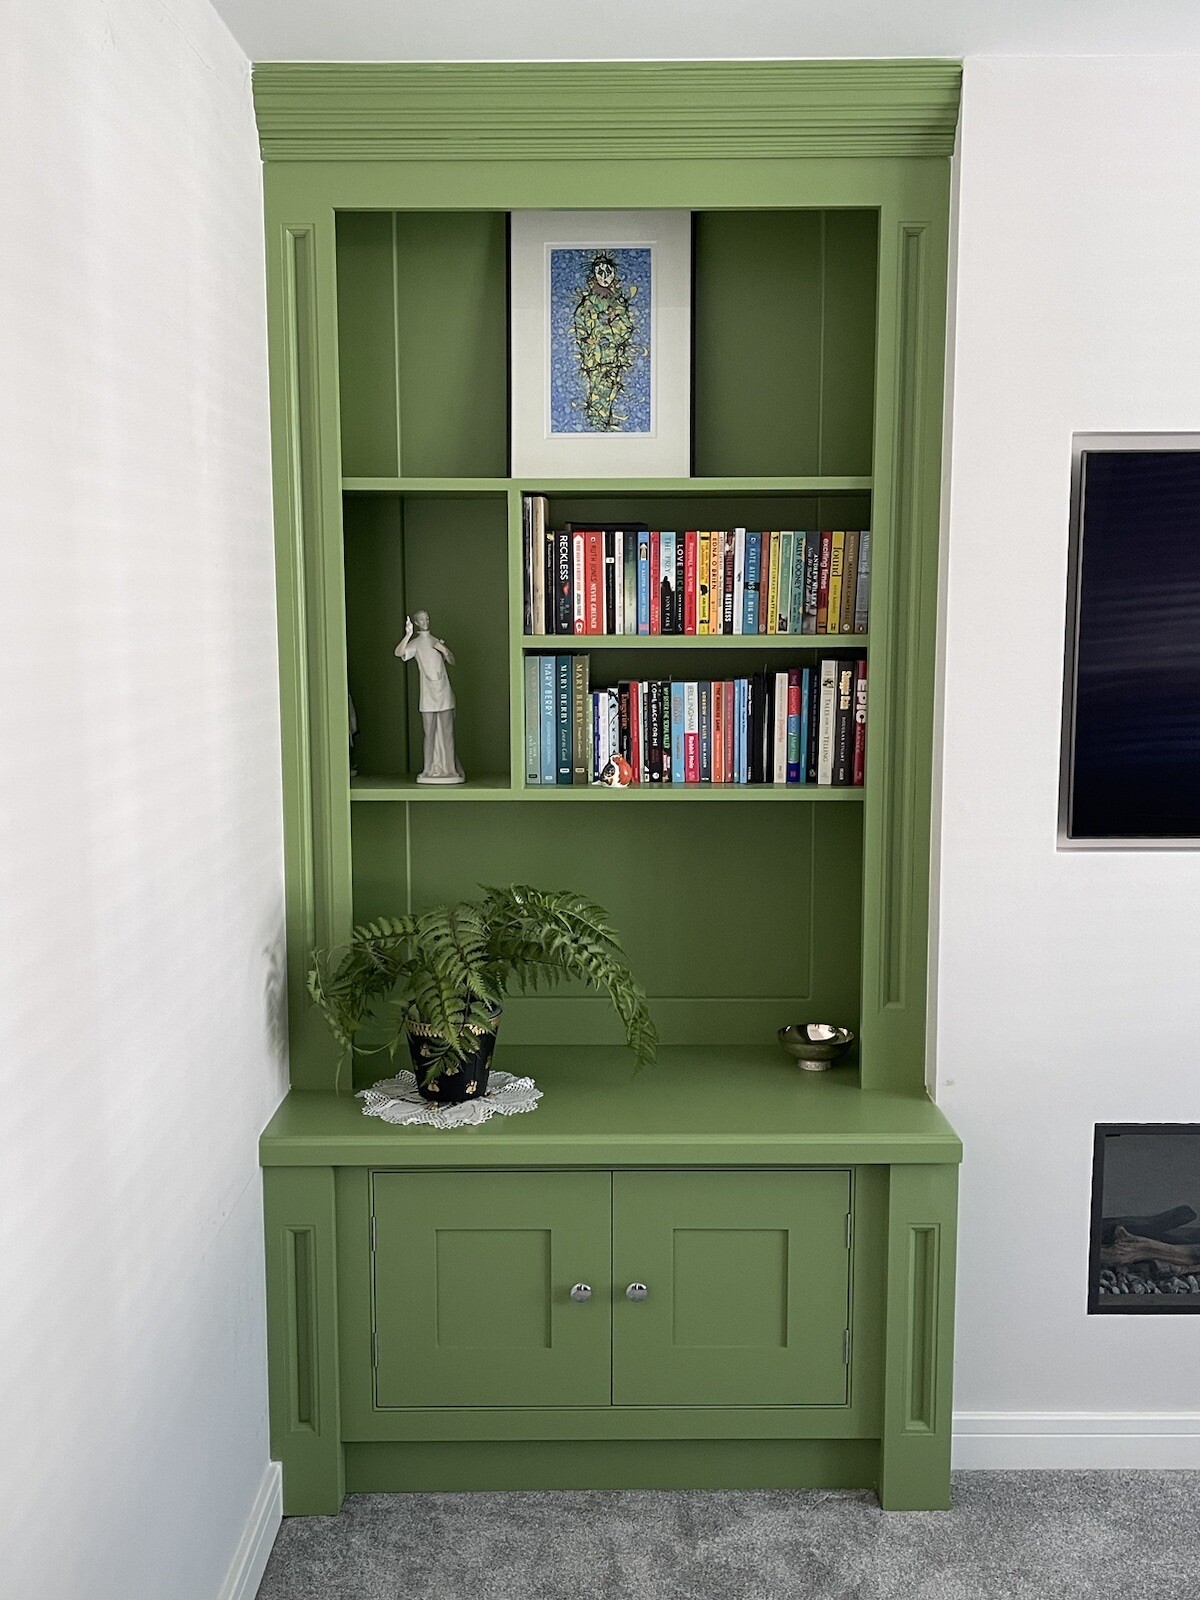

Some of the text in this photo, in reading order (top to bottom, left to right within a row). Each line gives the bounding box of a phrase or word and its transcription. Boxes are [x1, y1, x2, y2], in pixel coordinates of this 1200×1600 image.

[560, 535, 568, 580] RECKLESS
[820, 538, 829, 567] exciting
[794, 559, 803, 589] ROONEY
[545, 690, 553, 717] BERRY
[620, 692, 629, 730] Tangerine
[856, 679, 867, 724] EPIC
